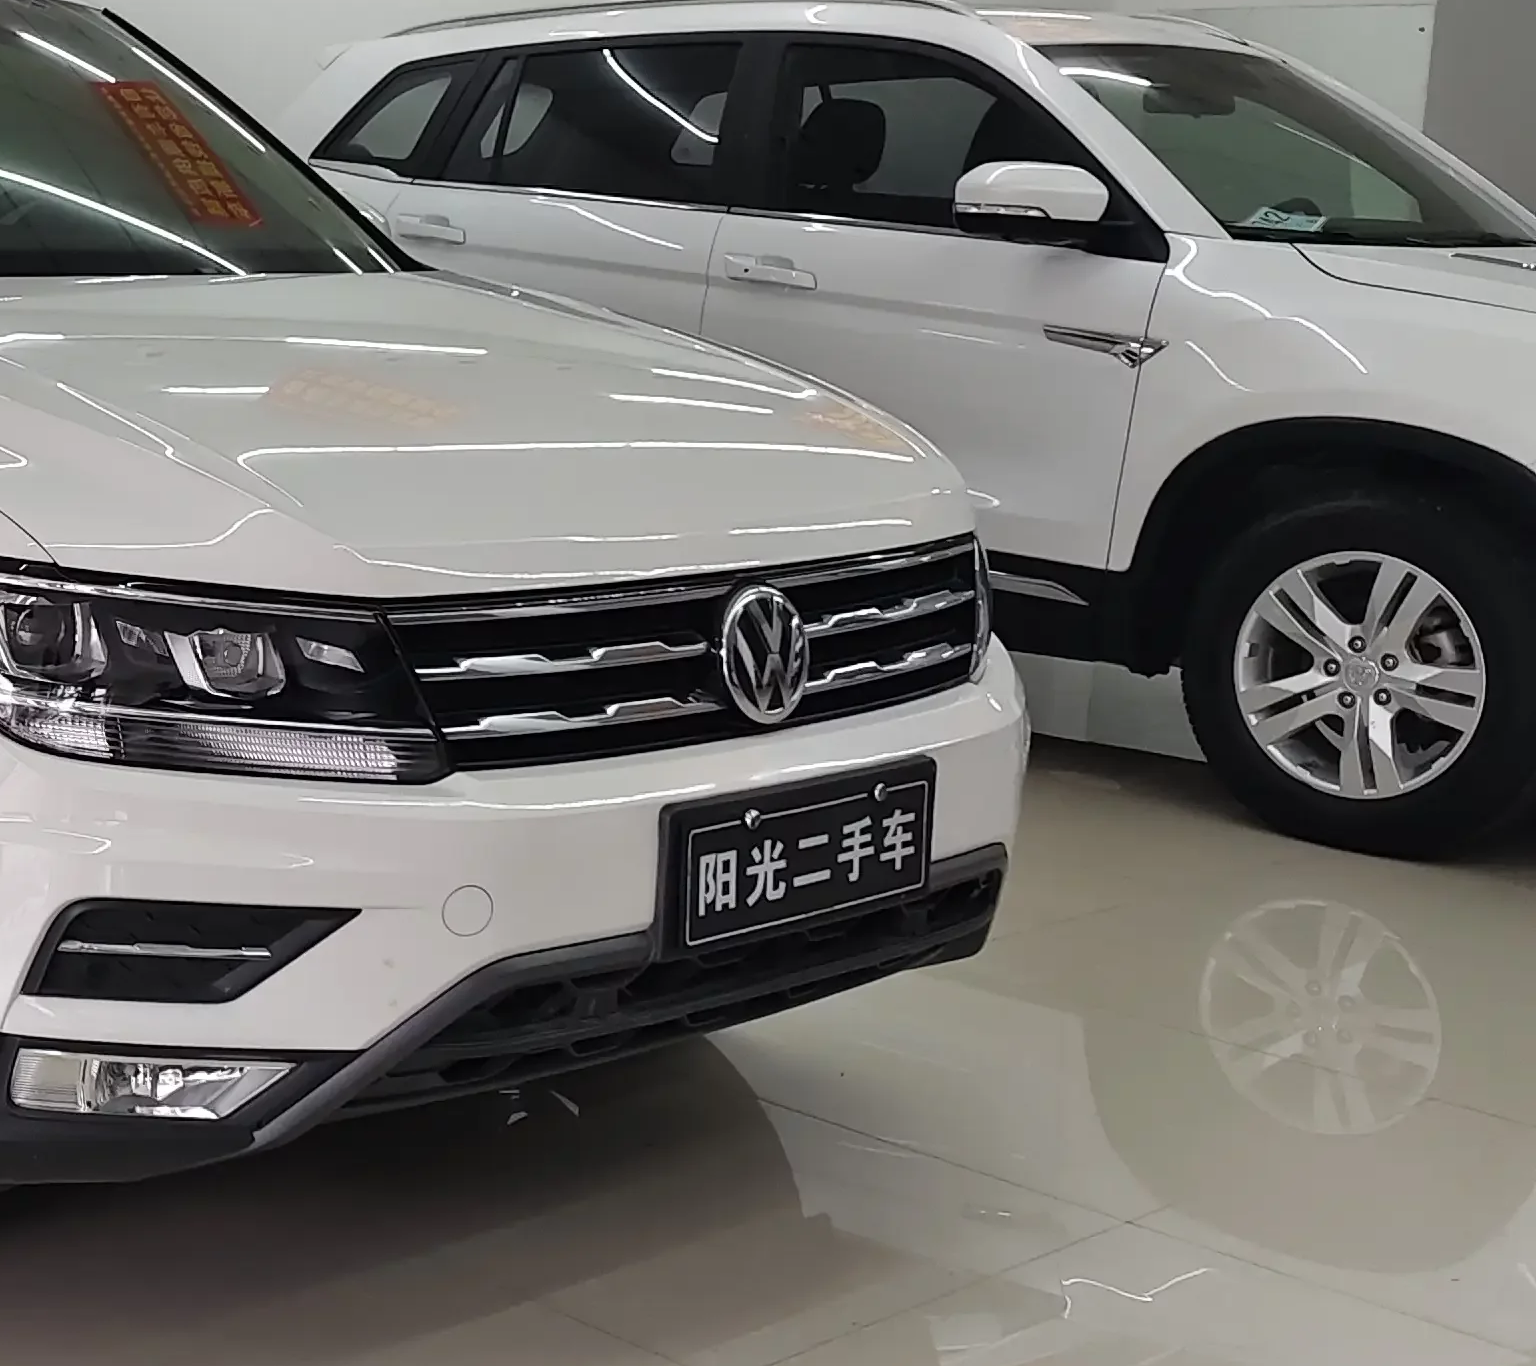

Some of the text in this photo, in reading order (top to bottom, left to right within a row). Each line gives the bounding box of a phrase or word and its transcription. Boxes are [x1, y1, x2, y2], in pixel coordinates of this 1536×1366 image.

[698, 809, 916, 917] 阳光二手车
